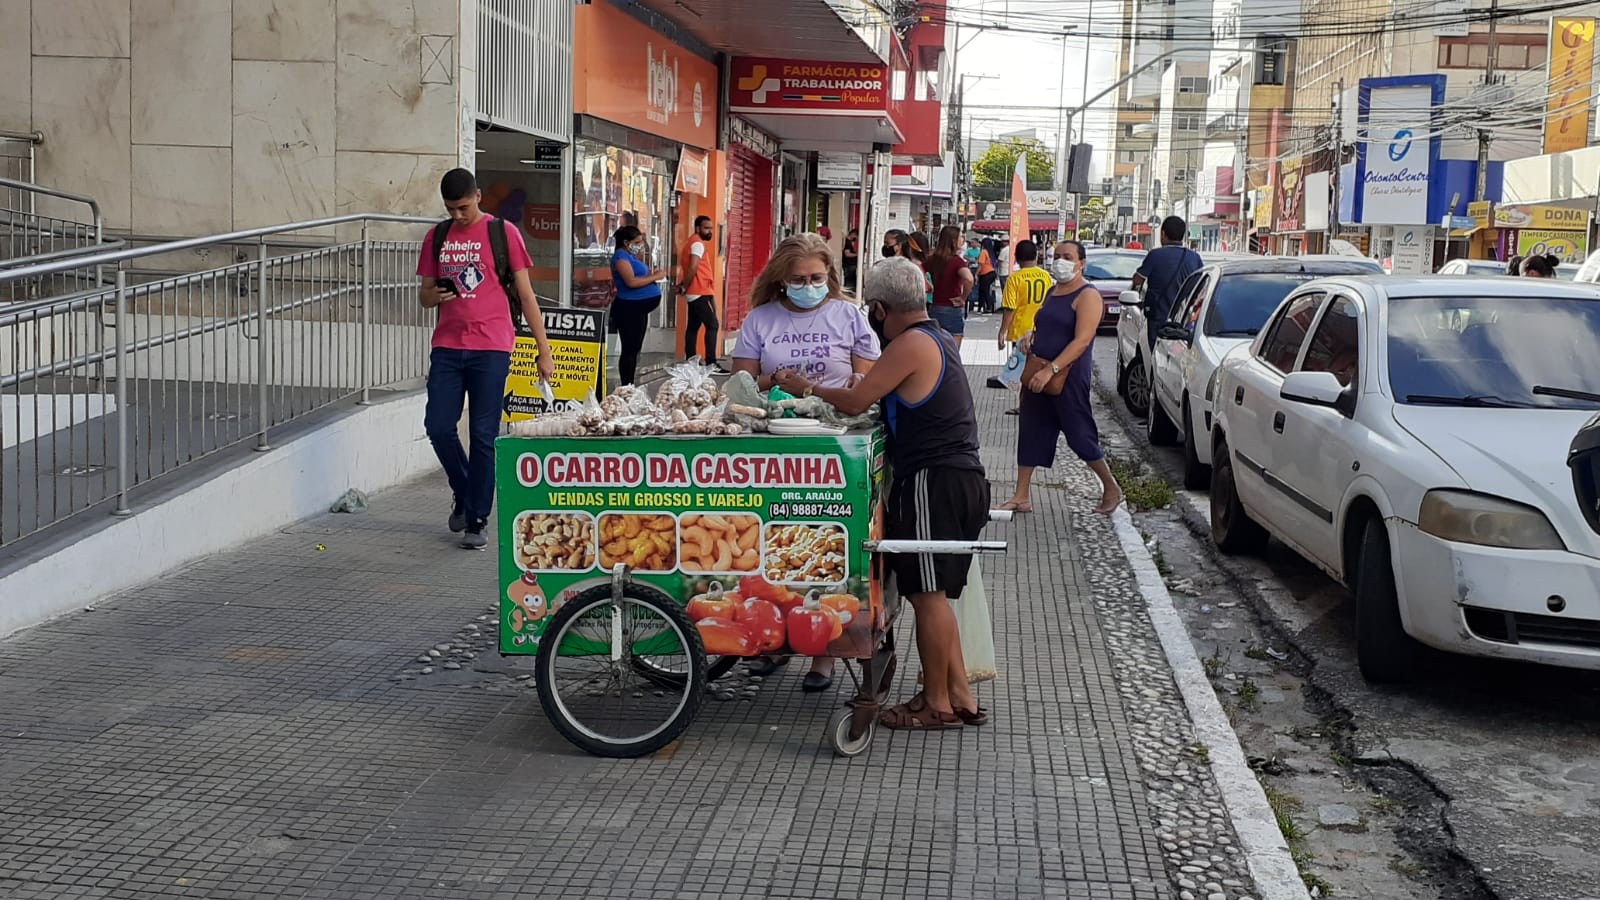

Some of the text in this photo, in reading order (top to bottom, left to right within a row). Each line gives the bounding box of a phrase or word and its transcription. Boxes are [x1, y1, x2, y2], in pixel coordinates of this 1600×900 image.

[784, 64, 881, 78] FARMÁCIA DO
[647, 41, 678, 125] help!
[784, 79, 882, 90] TRABALHADOR
[841, 91, 880, 104] Popular
[1544, 210, 1582, 220] DONA
[439, 252, 450, 262] de
[1025, 279, 1045, 304] 10
[772, 332, 829, 344] CÂNCER
[560, 346, 583, 354] CANAL
[791, 349, 809, 358] DE
[566, 373, 590, 381] MÓVEL
[509, 396, 542, 405] FAÇA SUA
[507, 405, 542, 413] CONSULTA
[518, 454, 540, 485] O
[546, 455, 642, 485] CARRO
[648, 455, 689, 485] DA
[693, 455, 845, 486] CASTANHA
[549, 493, 763, 507] VENDAS EM GROSSO E VAREJO
[781, 491, 843, 501] ORG. ARAÚJO
[769, 503, 852, 518] (84) 98887-4244
